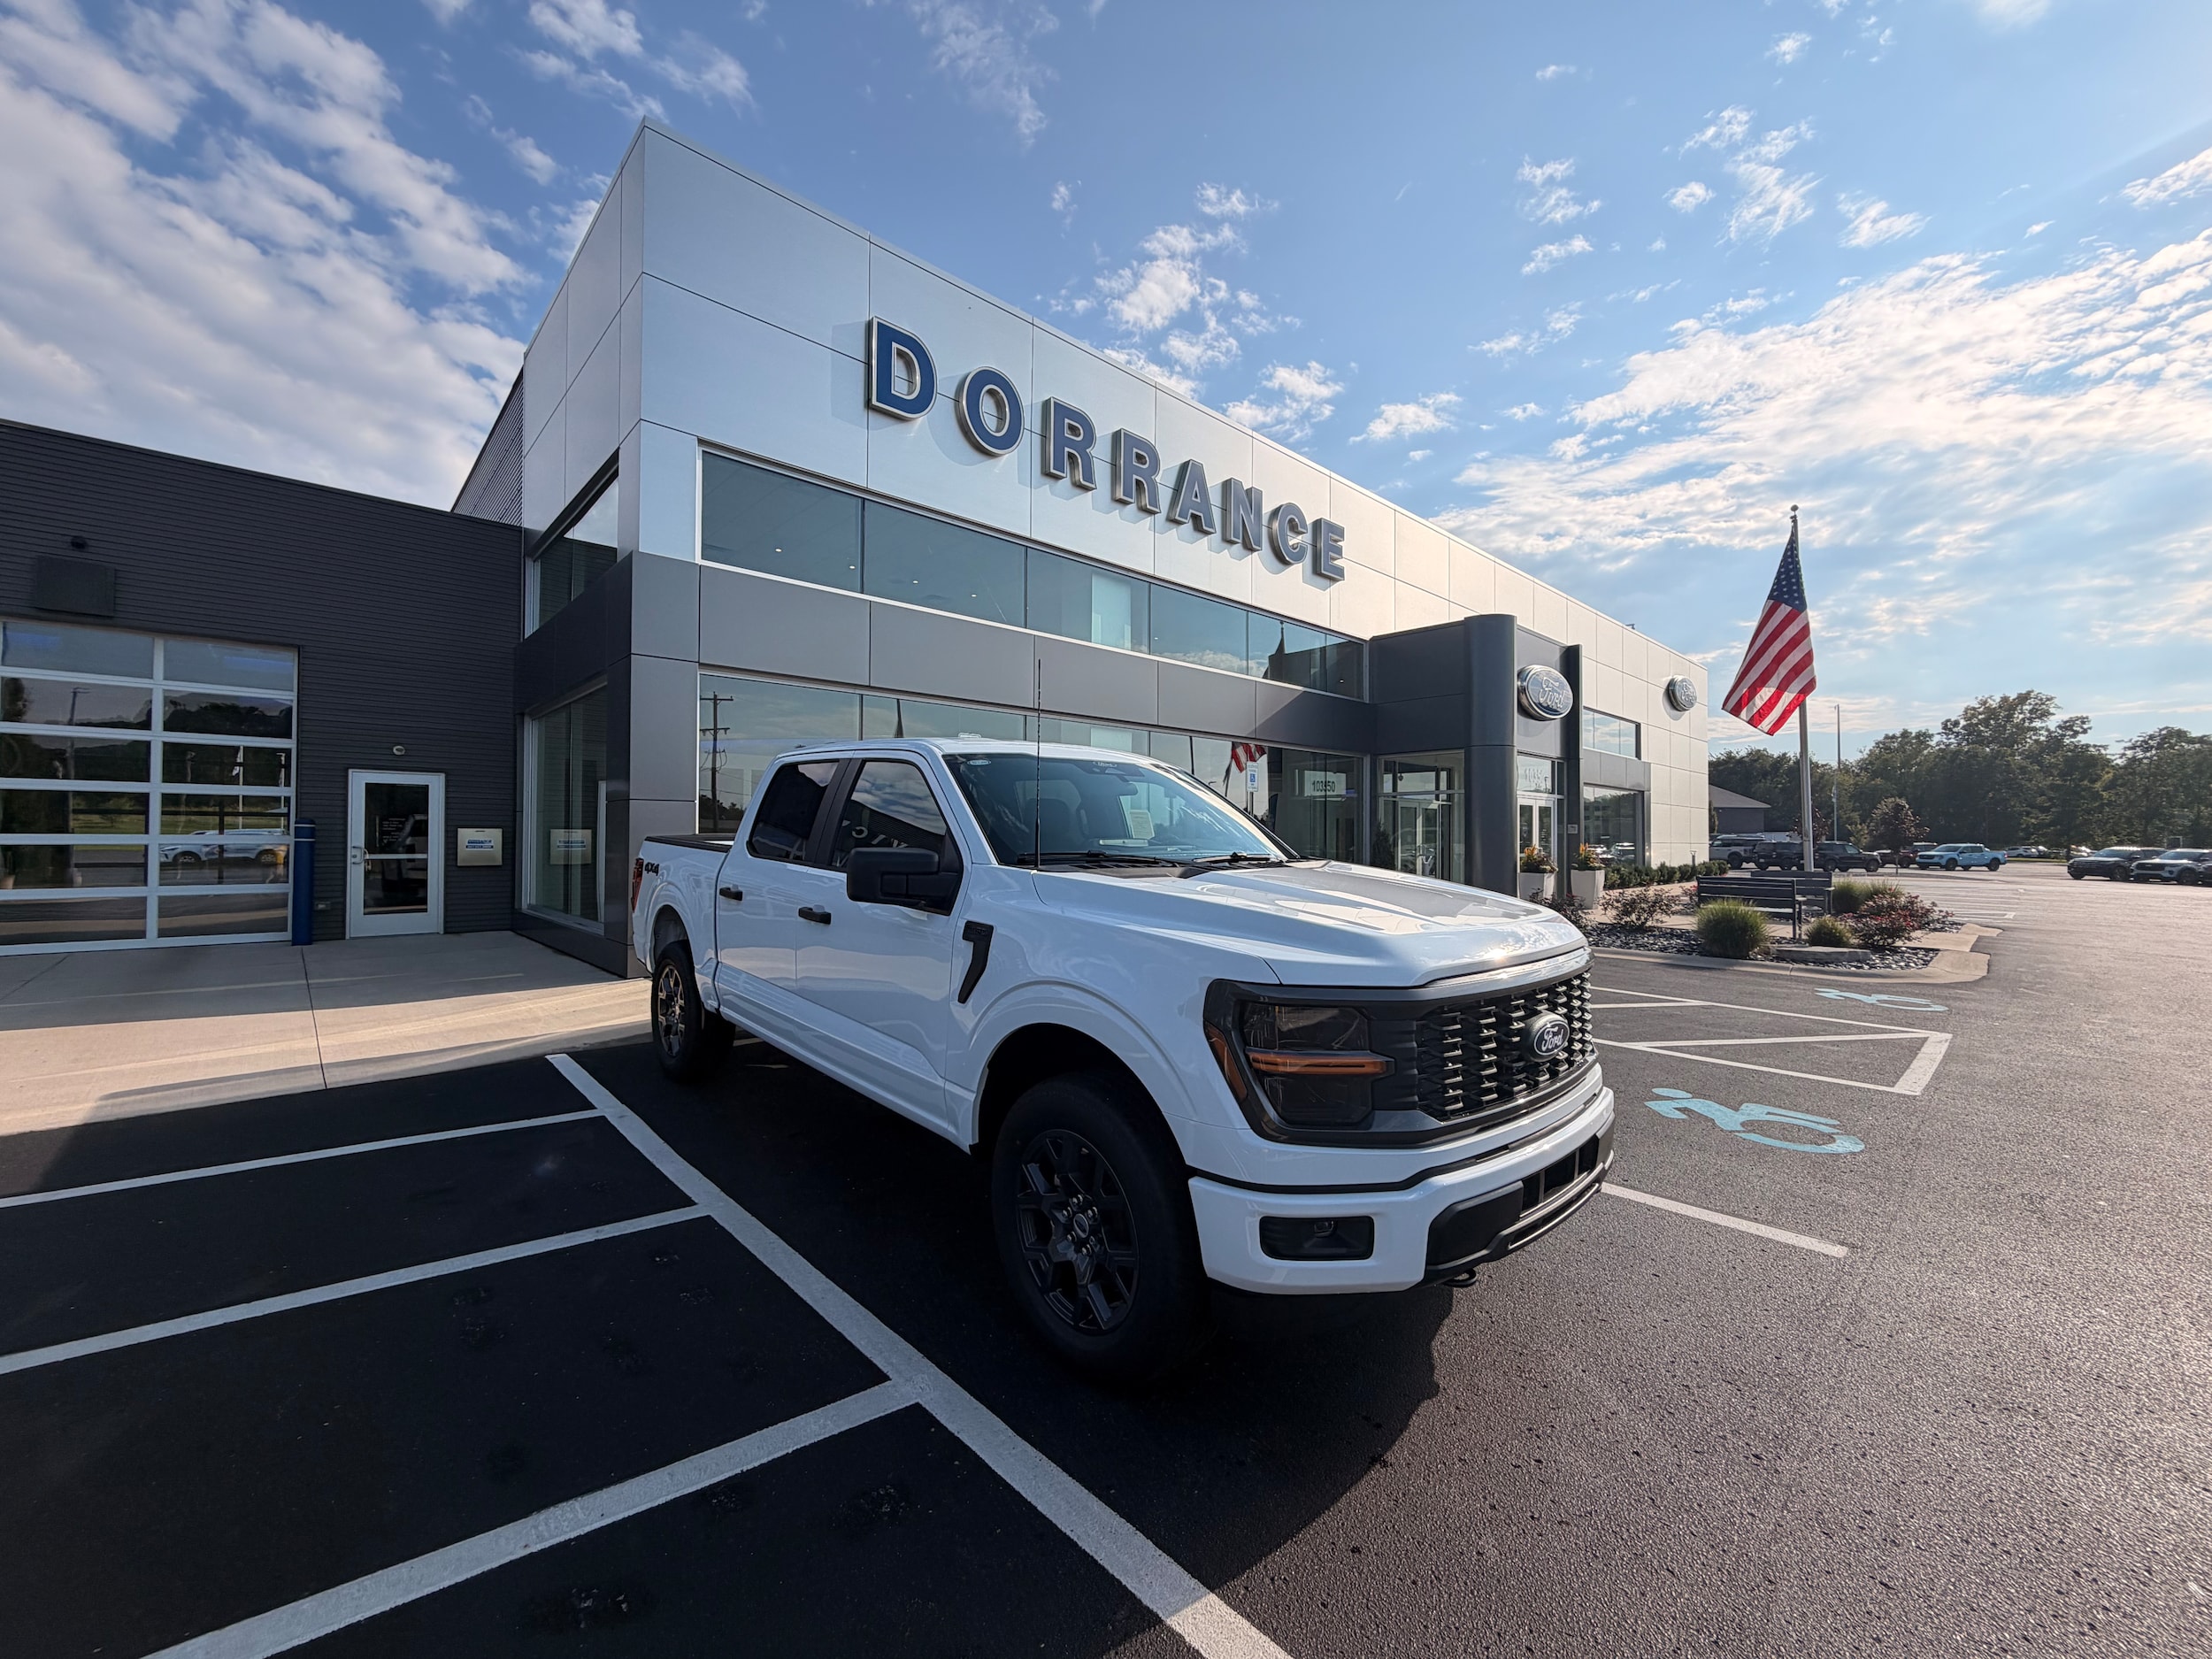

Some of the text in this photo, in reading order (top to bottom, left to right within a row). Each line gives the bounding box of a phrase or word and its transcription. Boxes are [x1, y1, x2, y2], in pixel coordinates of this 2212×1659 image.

[869, 316, 1345, 581] DORRANCE
[1540, 676, 1566, 708] Ford
[1541, 1025, 1564, 1051] Ford
